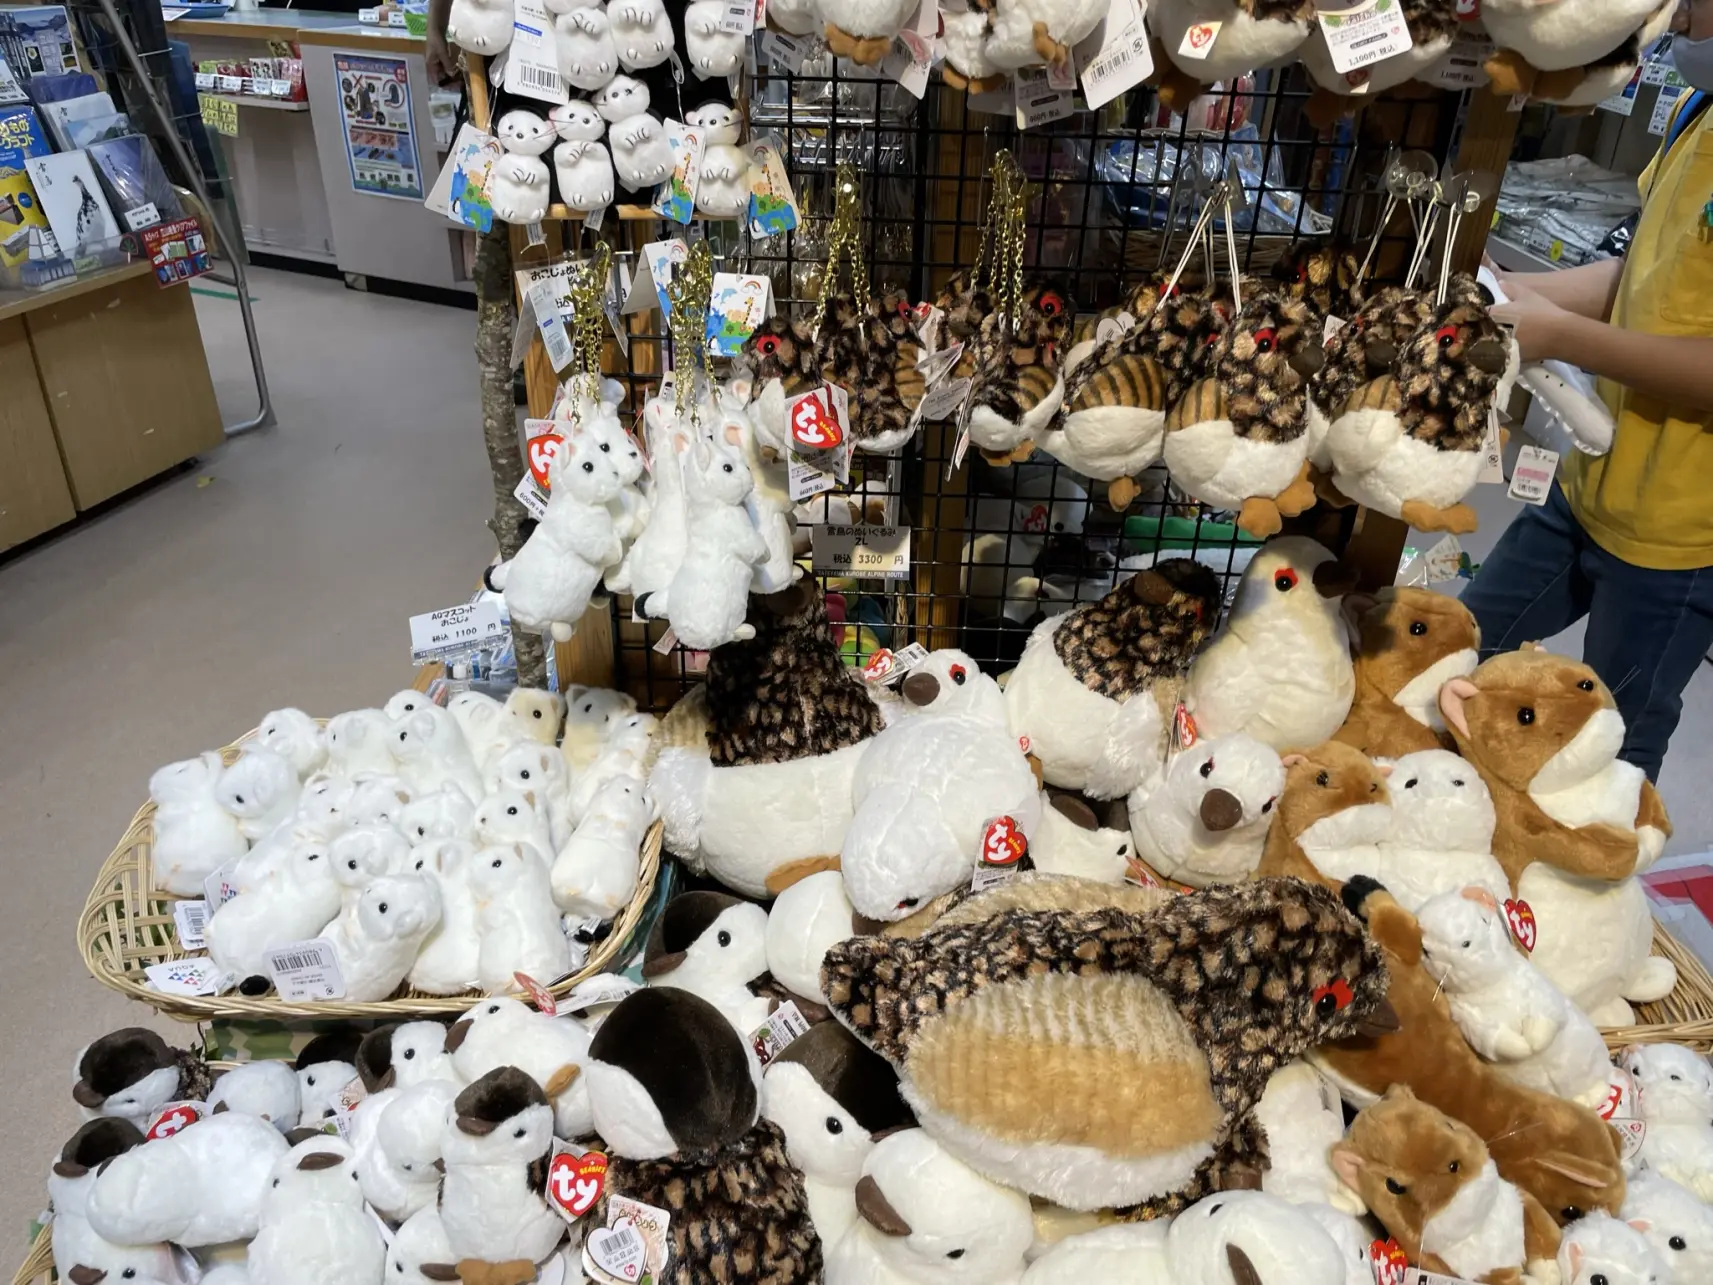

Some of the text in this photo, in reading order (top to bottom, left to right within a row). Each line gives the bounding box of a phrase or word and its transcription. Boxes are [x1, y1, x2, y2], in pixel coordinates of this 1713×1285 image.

[796, 402, 825, 443] ty
[826, 526, 897, 537] 雷鳥のぬいぐるみ
[855, 537, 869, 546] 2L
[833, 553, 904, 565] 税込 3300 円
[432, 622, 497, 643] 税込 1100 円
[440, 616, 469, 627] おこじょ
[987, 824, 1012, 861] ty
[1510, 909, 1534, 948] ty
[155, 1111, 188, 1138] t
[552, 1164, 598, 1211] ty
